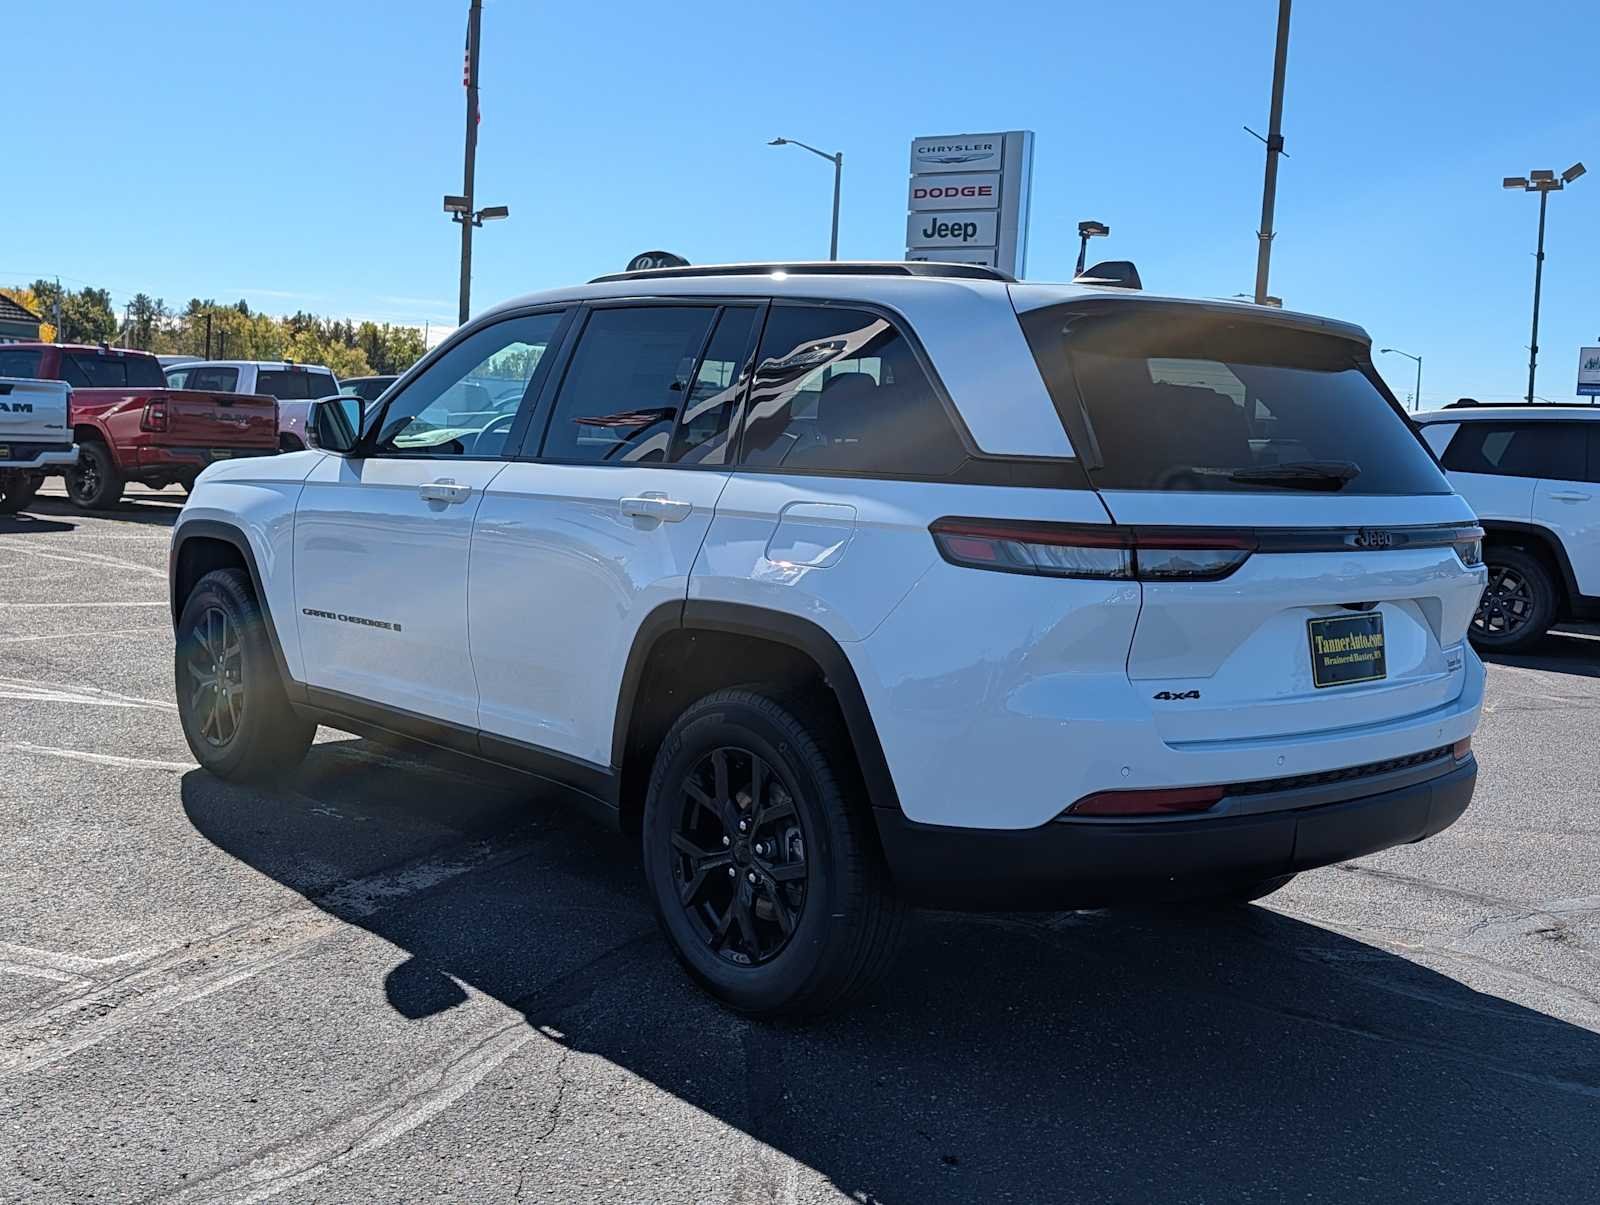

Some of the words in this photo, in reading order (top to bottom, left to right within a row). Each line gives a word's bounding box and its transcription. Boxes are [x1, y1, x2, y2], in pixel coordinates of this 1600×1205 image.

[918, 144, 993, 154] CHRYSLER
[913, 186, 993, 199] DODGE
[922, 217, 978, 242] Jeep
[1151, 690, 1200, 701] 4x4
